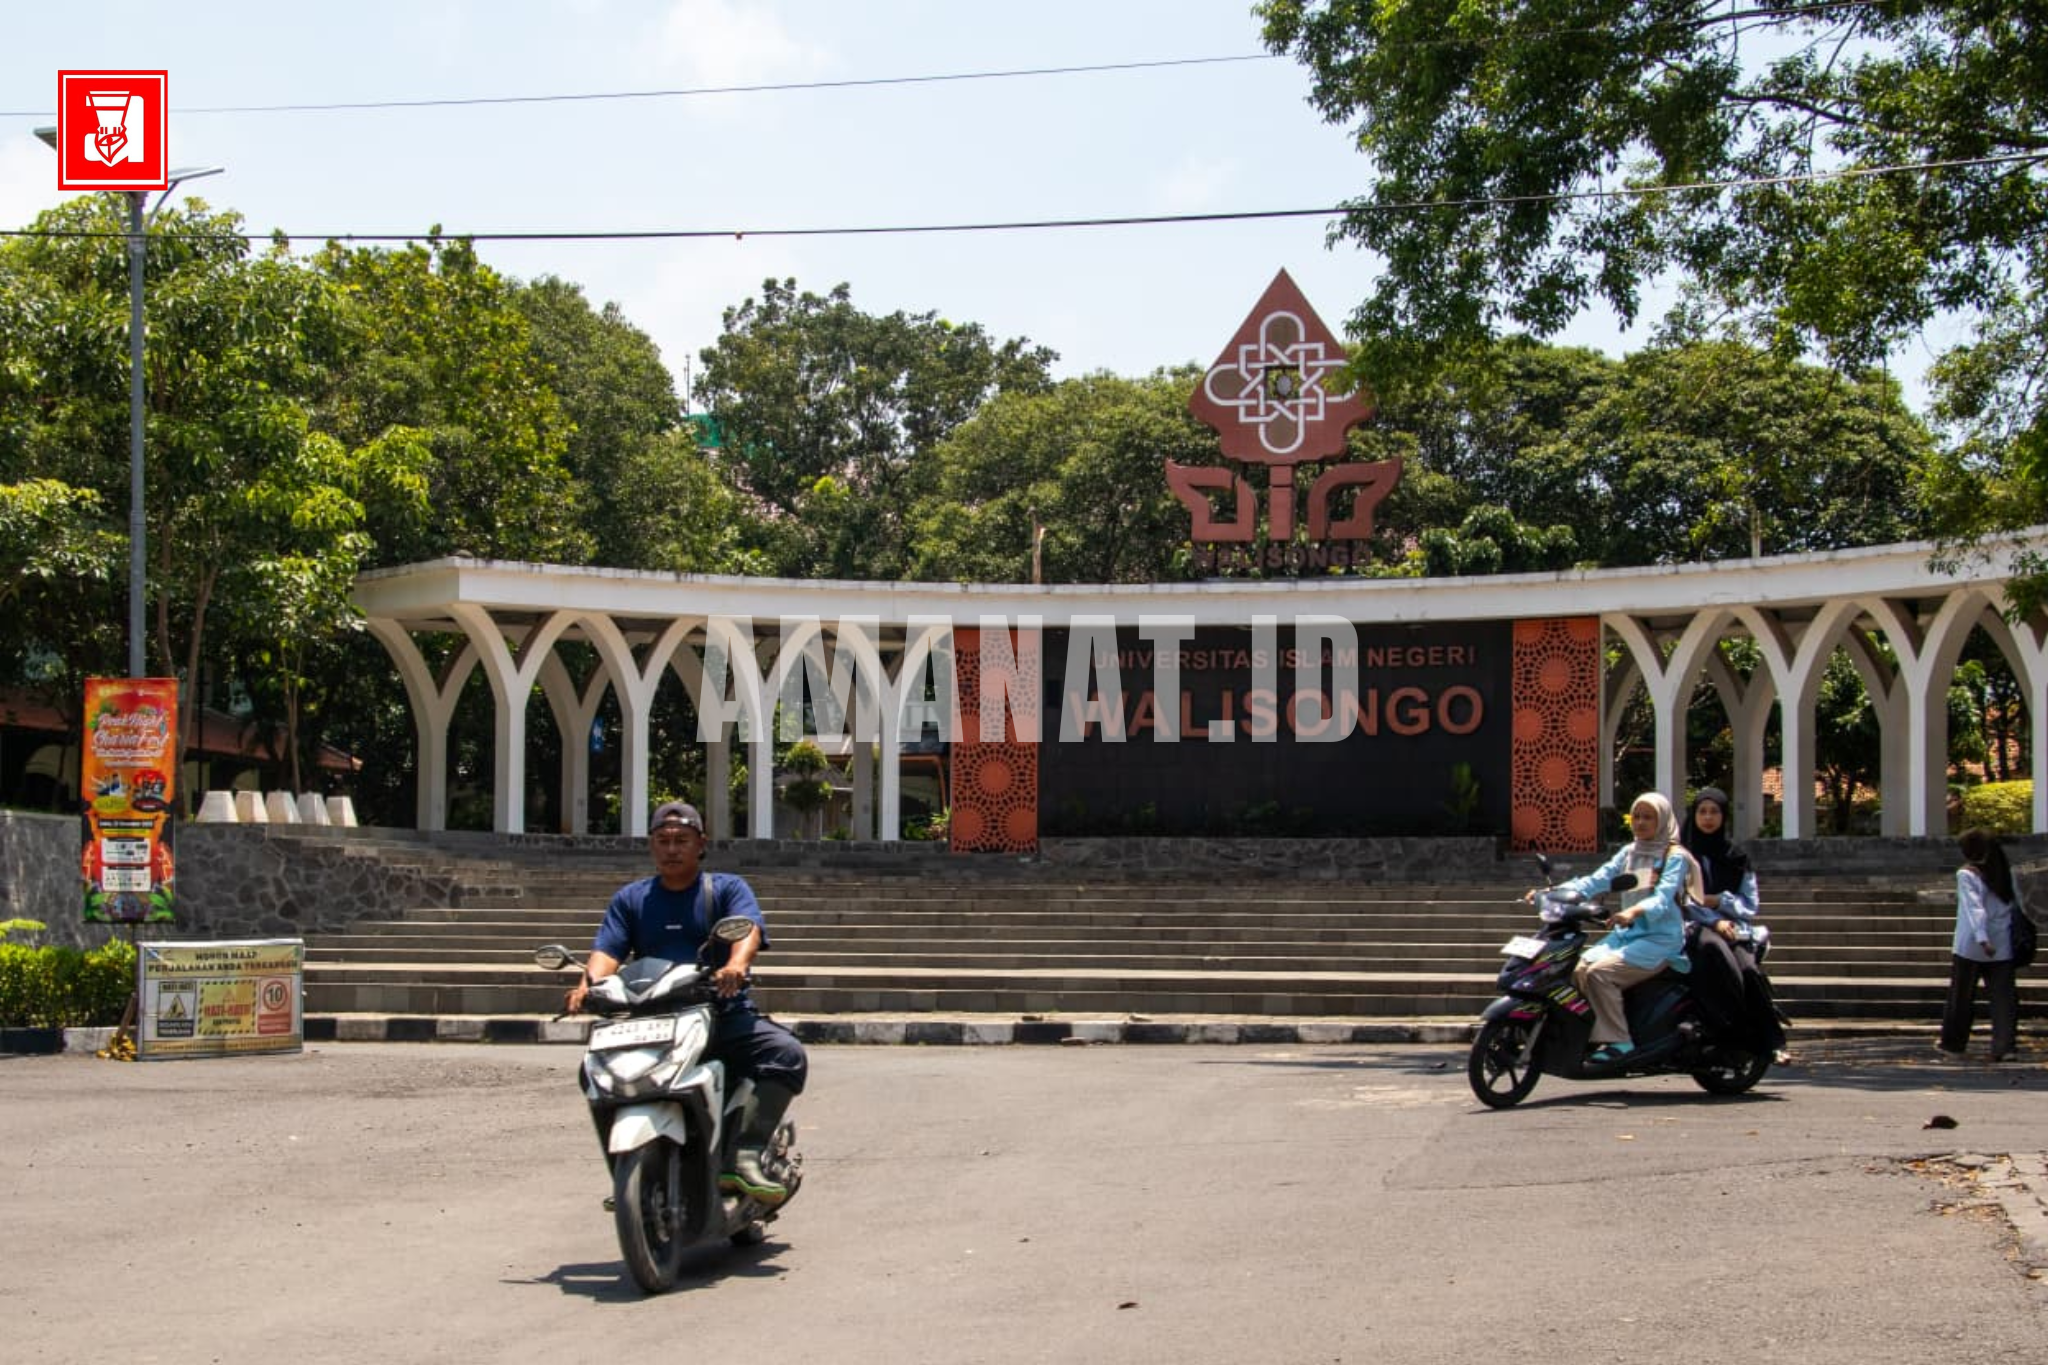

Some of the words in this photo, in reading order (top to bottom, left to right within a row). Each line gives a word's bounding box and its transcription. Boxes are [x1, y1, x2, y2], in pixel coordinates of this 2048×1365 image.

[1092, 648, 1269, 671] UNIVERSITAS
[1279, 647, 1359, 669] ISLAM
[1367, 645, 1476, 668] NEGERI
[1067, 684, 1485, 738] WALISONGO
[148, 963, 216, 973] PERJALANAN
[217, 962, 242, 971] ANDA
[268, 987, 283, 1002] 10
